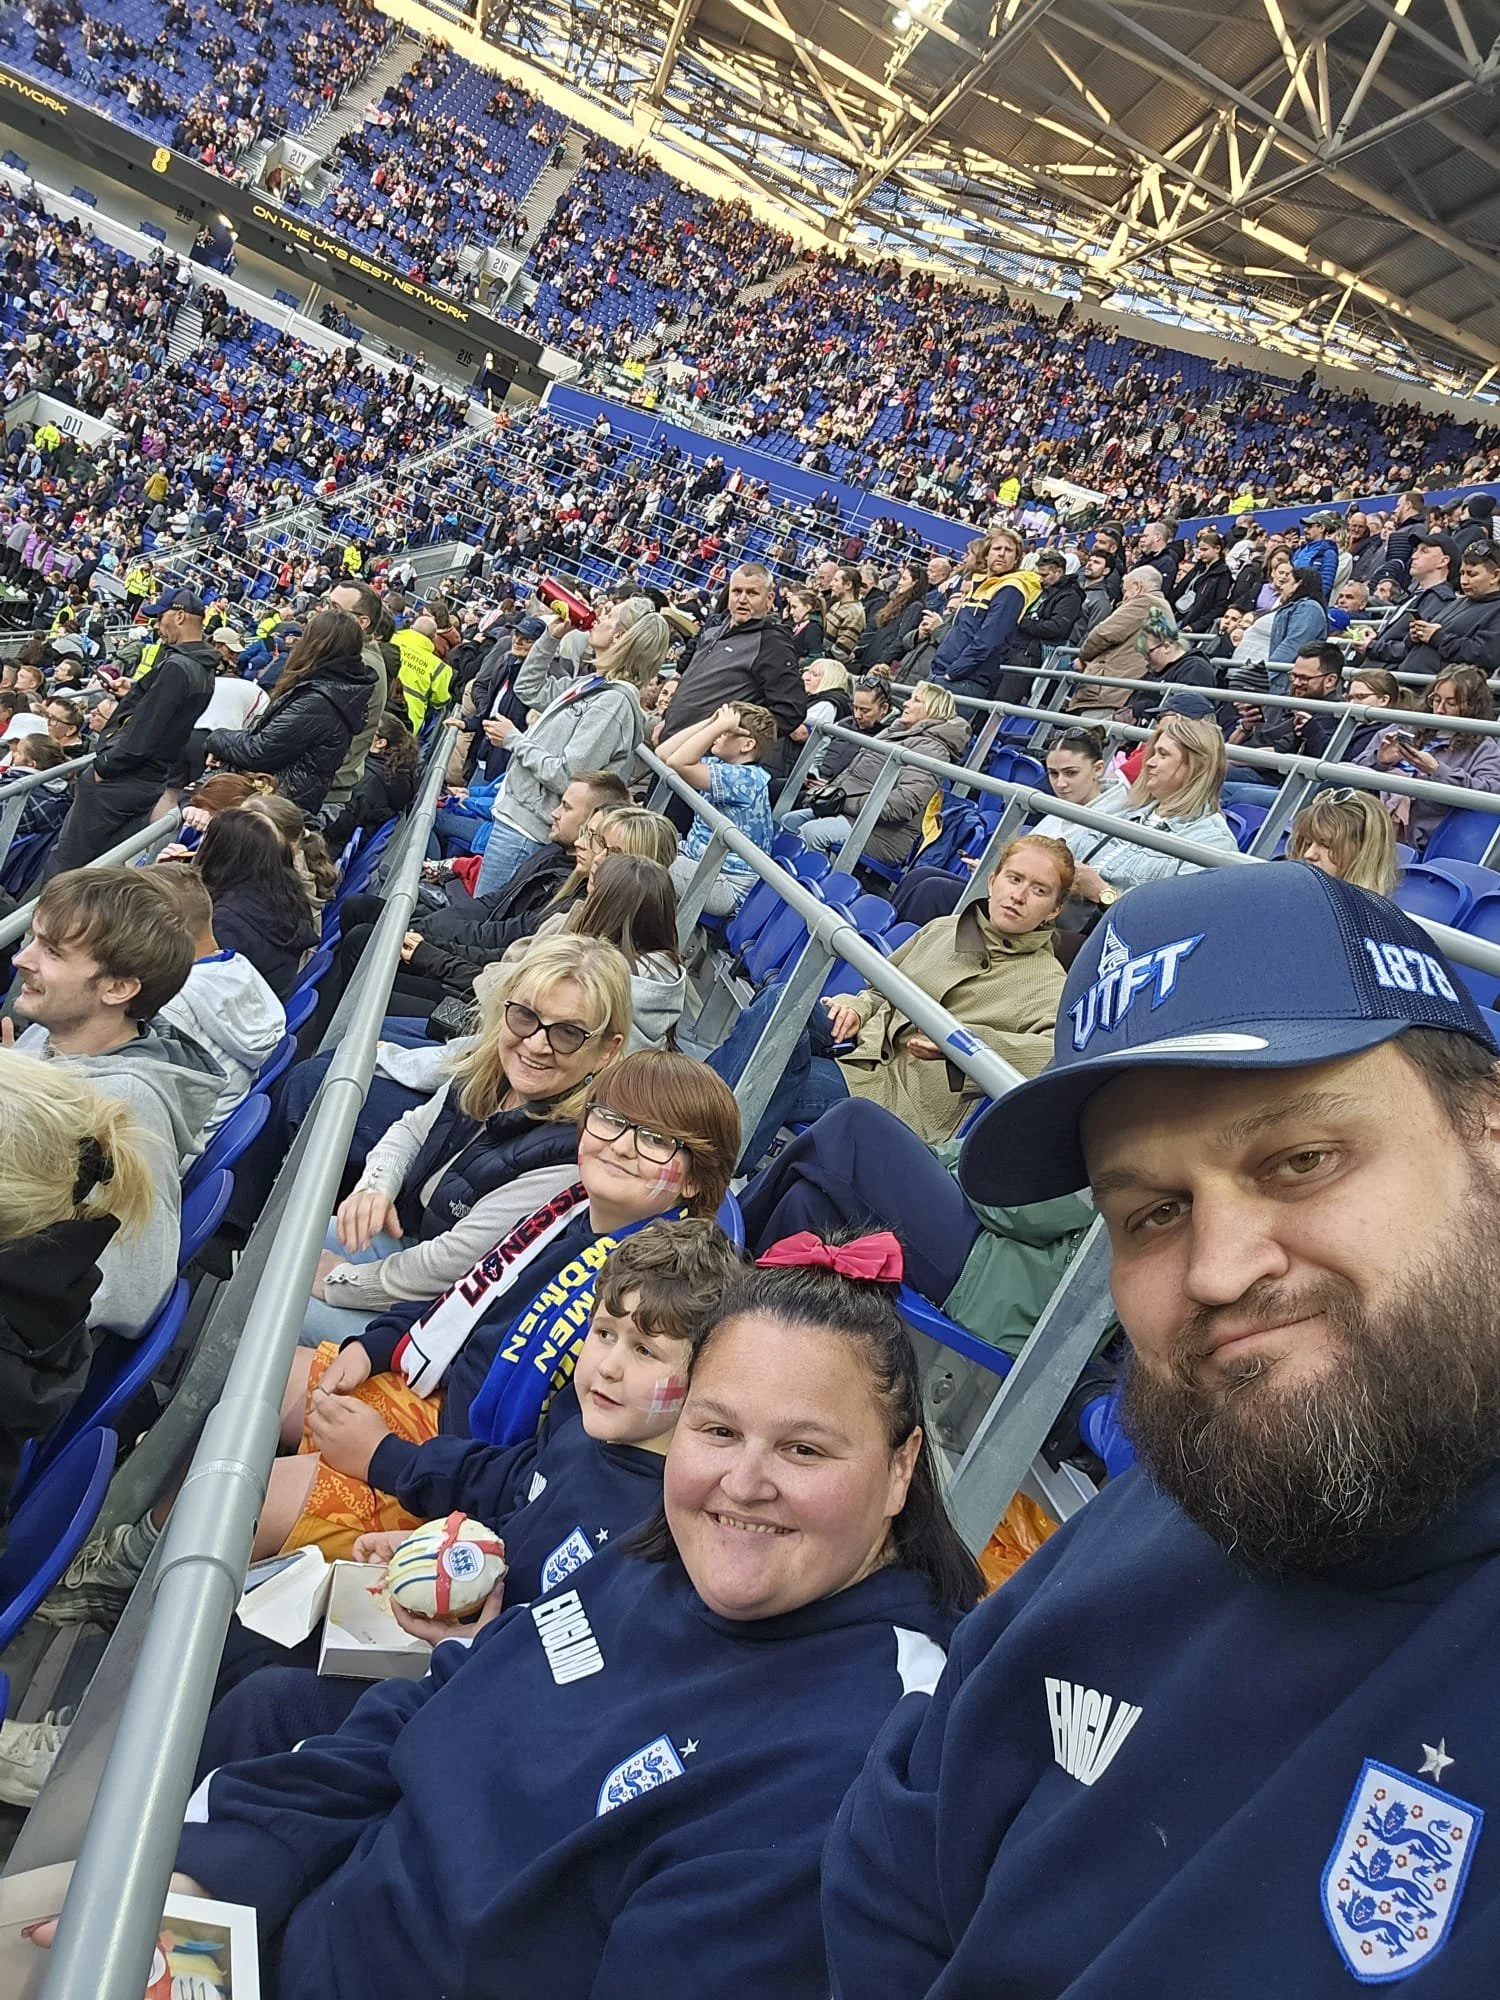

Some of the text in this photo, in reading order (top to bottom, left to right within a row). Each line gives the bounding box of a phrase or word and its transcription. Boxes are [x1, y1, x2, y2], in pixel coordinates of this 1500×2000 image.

[290, 150, 307, 166] 217
[252, 206, 469, 323] ON THE UK'S BEST NETWORK
[493, 258, 509, 273] 216
[457, 348, 473, 365] 215
[63, 415, 83, 435] 011
[1364, 937, 1460, 1004] 1878
[531, 1589, 605, 1685] ENGLAND
